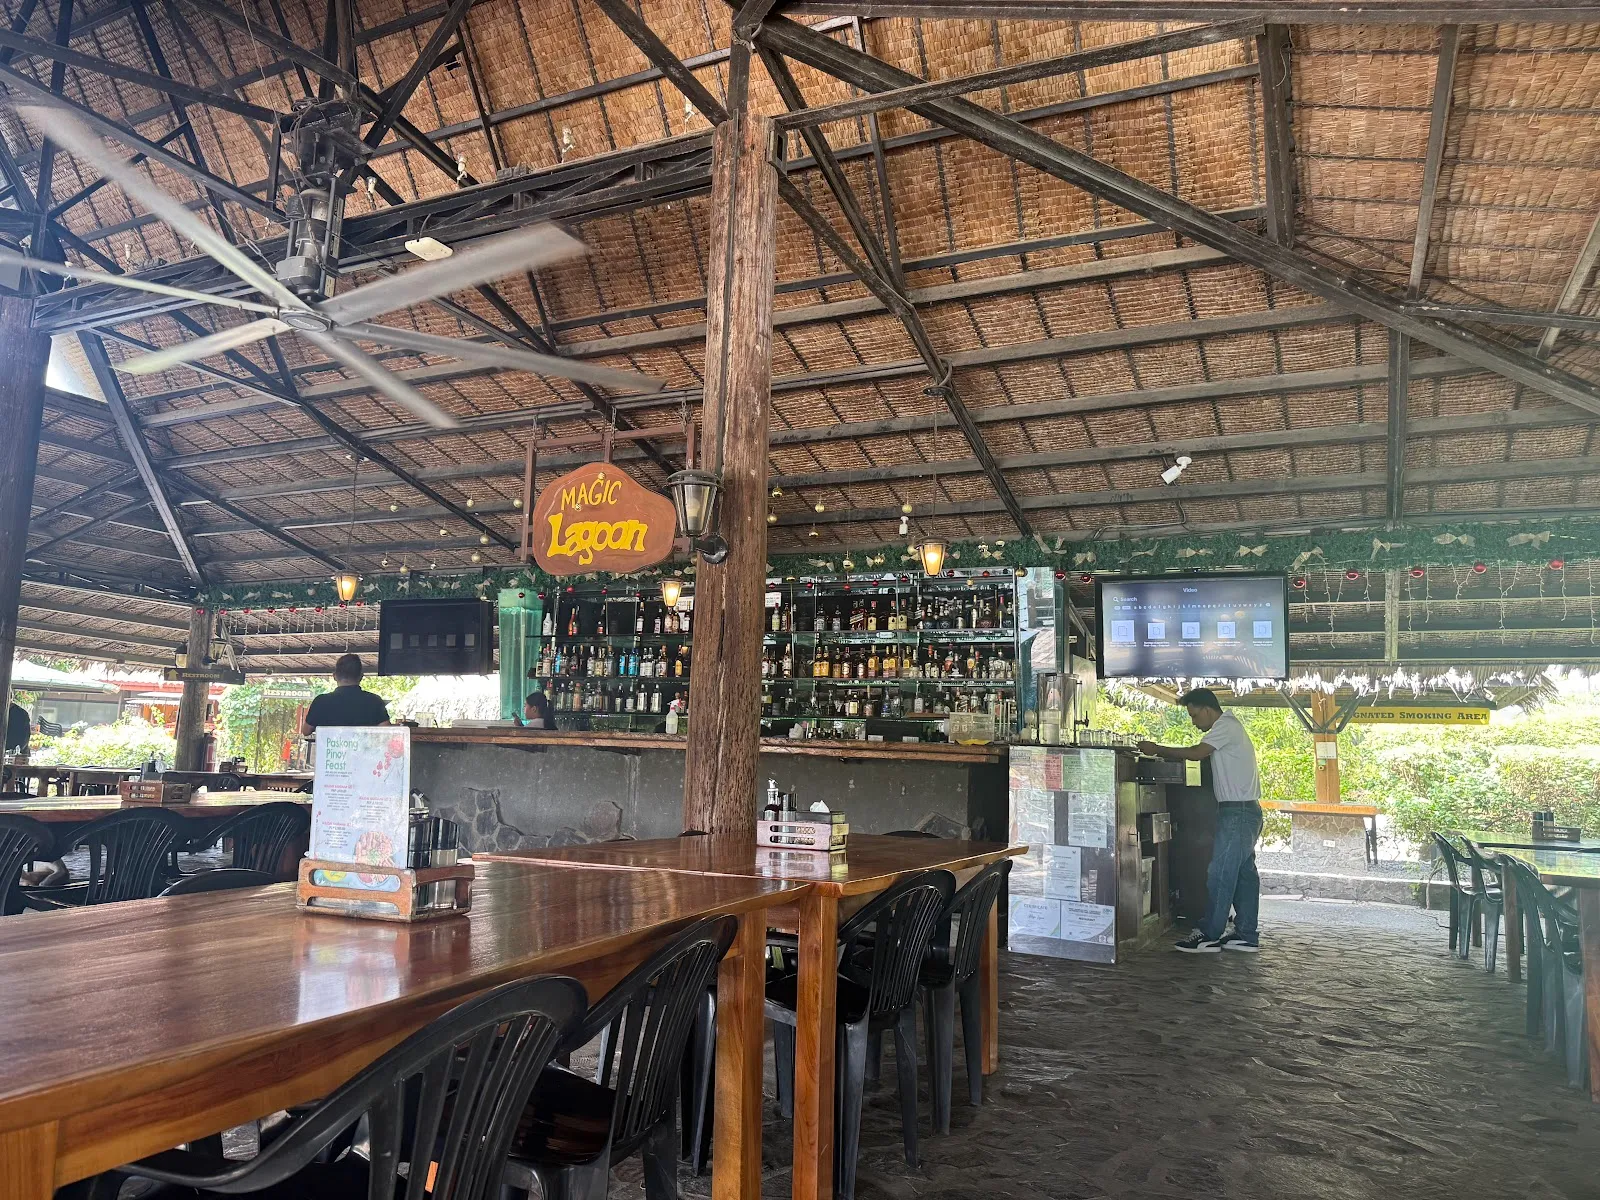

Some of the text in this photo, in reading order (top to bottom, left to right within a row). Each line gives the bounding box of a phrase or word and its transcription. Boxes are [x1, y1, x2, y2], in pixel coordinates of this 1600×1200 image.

[561, 479, 622, 511] MAGIC
[547, 513, 648, 565] Lagoon
[263, 689, 311, 697] RESTROOM
[1353, 711, 1488, 720] GNATED SMOKING AREA
[326, 737, 359, 752] Paskong
[326, 749, 347, 760] Pinoy
[325, 760, 347, 770] Feast
